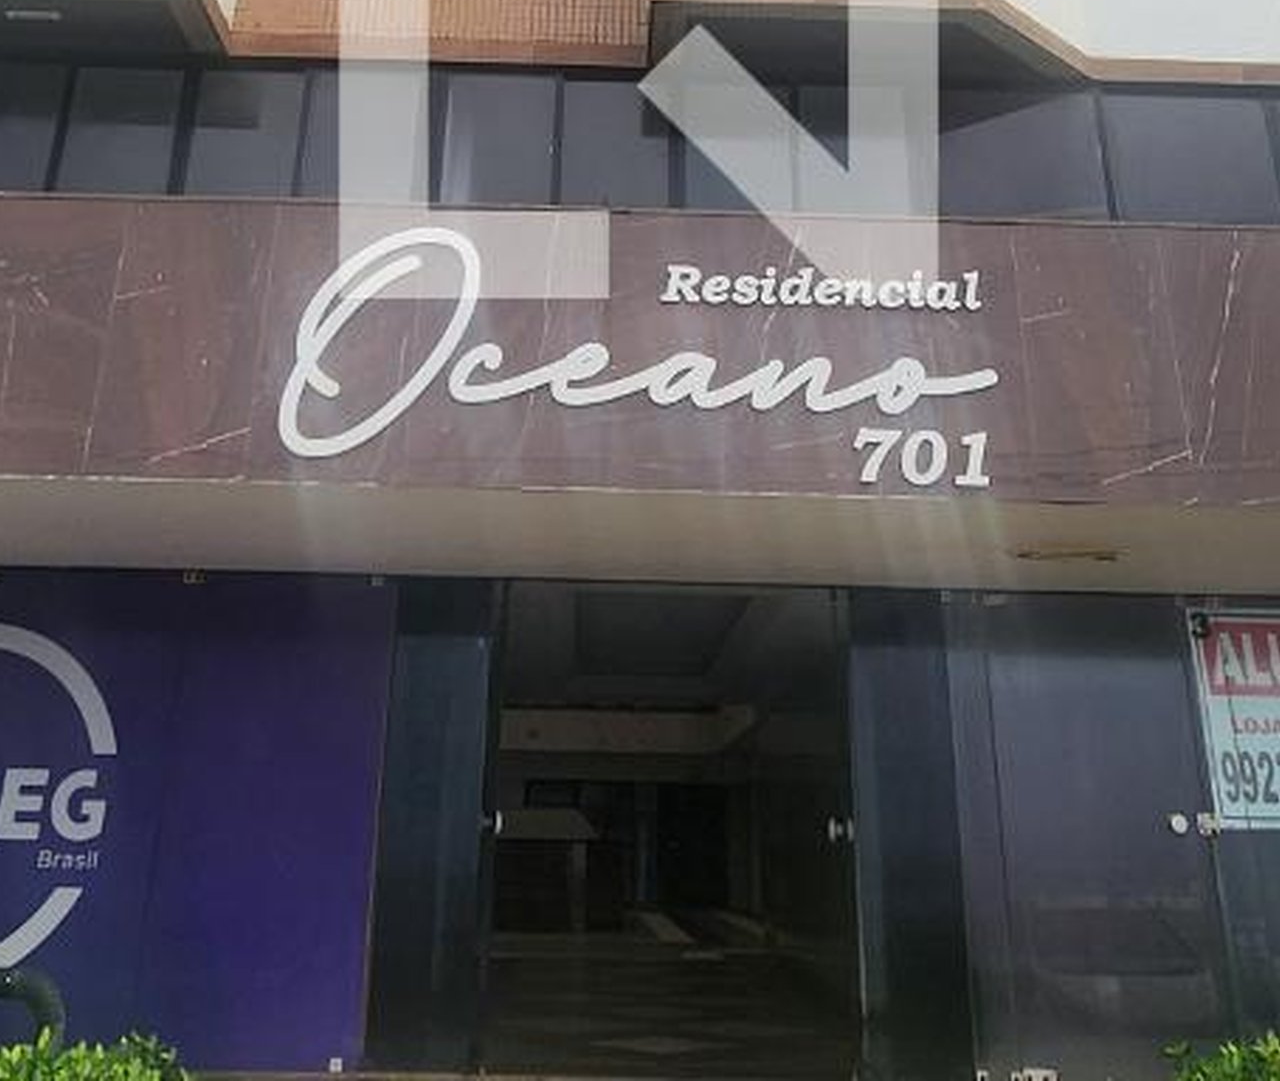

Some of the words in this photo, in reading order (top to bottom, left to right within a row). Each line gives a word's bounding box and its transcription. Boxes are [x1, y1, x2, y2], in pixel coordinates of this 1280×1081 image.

[660, 262, 983, 312] Residencial
[277, 226, 1000, 458] Oceano
[851, 428, 992, 488] 701
[35, 848, 100, 870] Brasil
